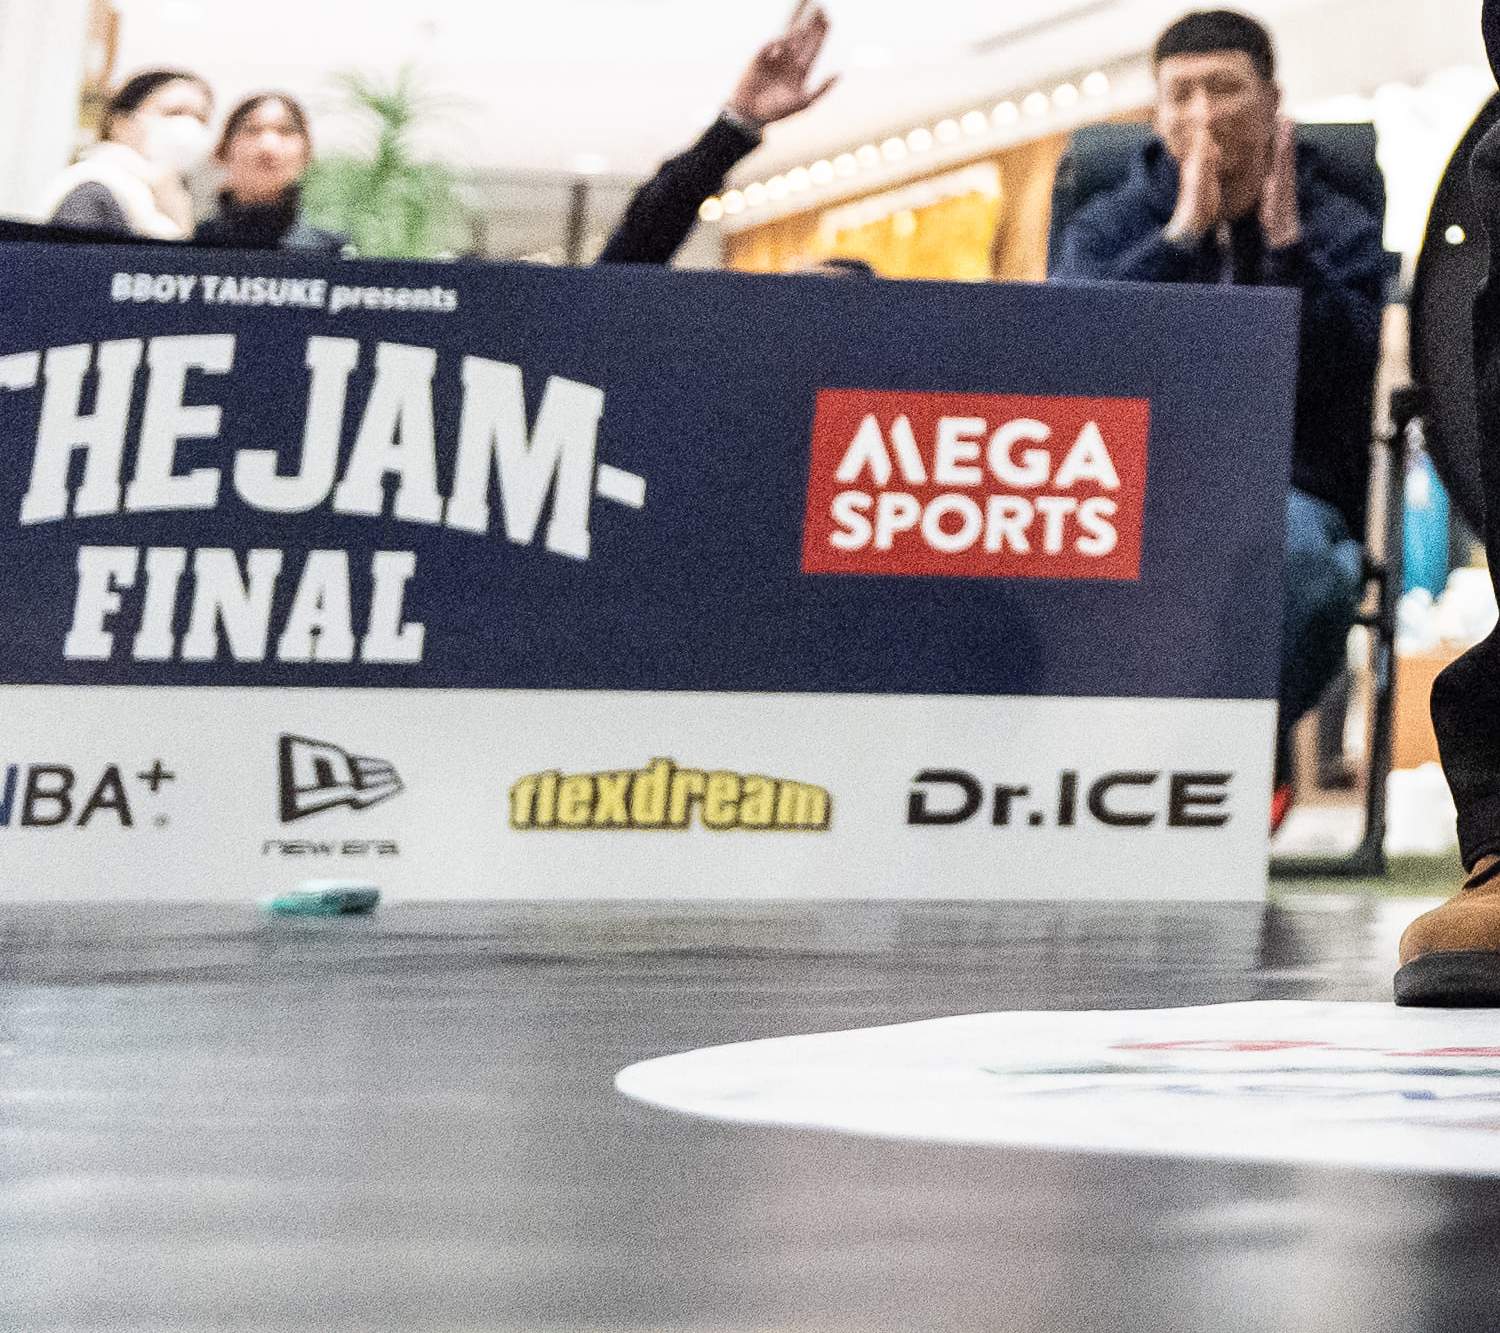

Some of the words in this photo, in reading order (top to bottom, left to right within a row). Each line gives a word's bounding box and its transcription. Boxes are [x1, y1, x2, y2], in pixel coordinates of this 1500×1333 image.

[111, 271, 199, 304] BBOY
[201, 274, 328, 307] TAISUKE
[328, 284, 459, 316] presents
[0, 333, 236, 528] HE
[232, 333, 648, 562] JAM-
[833, 411, 1125, 491] MEGA
[827, 488, 1121, 558] SPORTS
[61, 545, 426, 666] FINAL
[905, 768, 1235, 829] Dr.ICE
